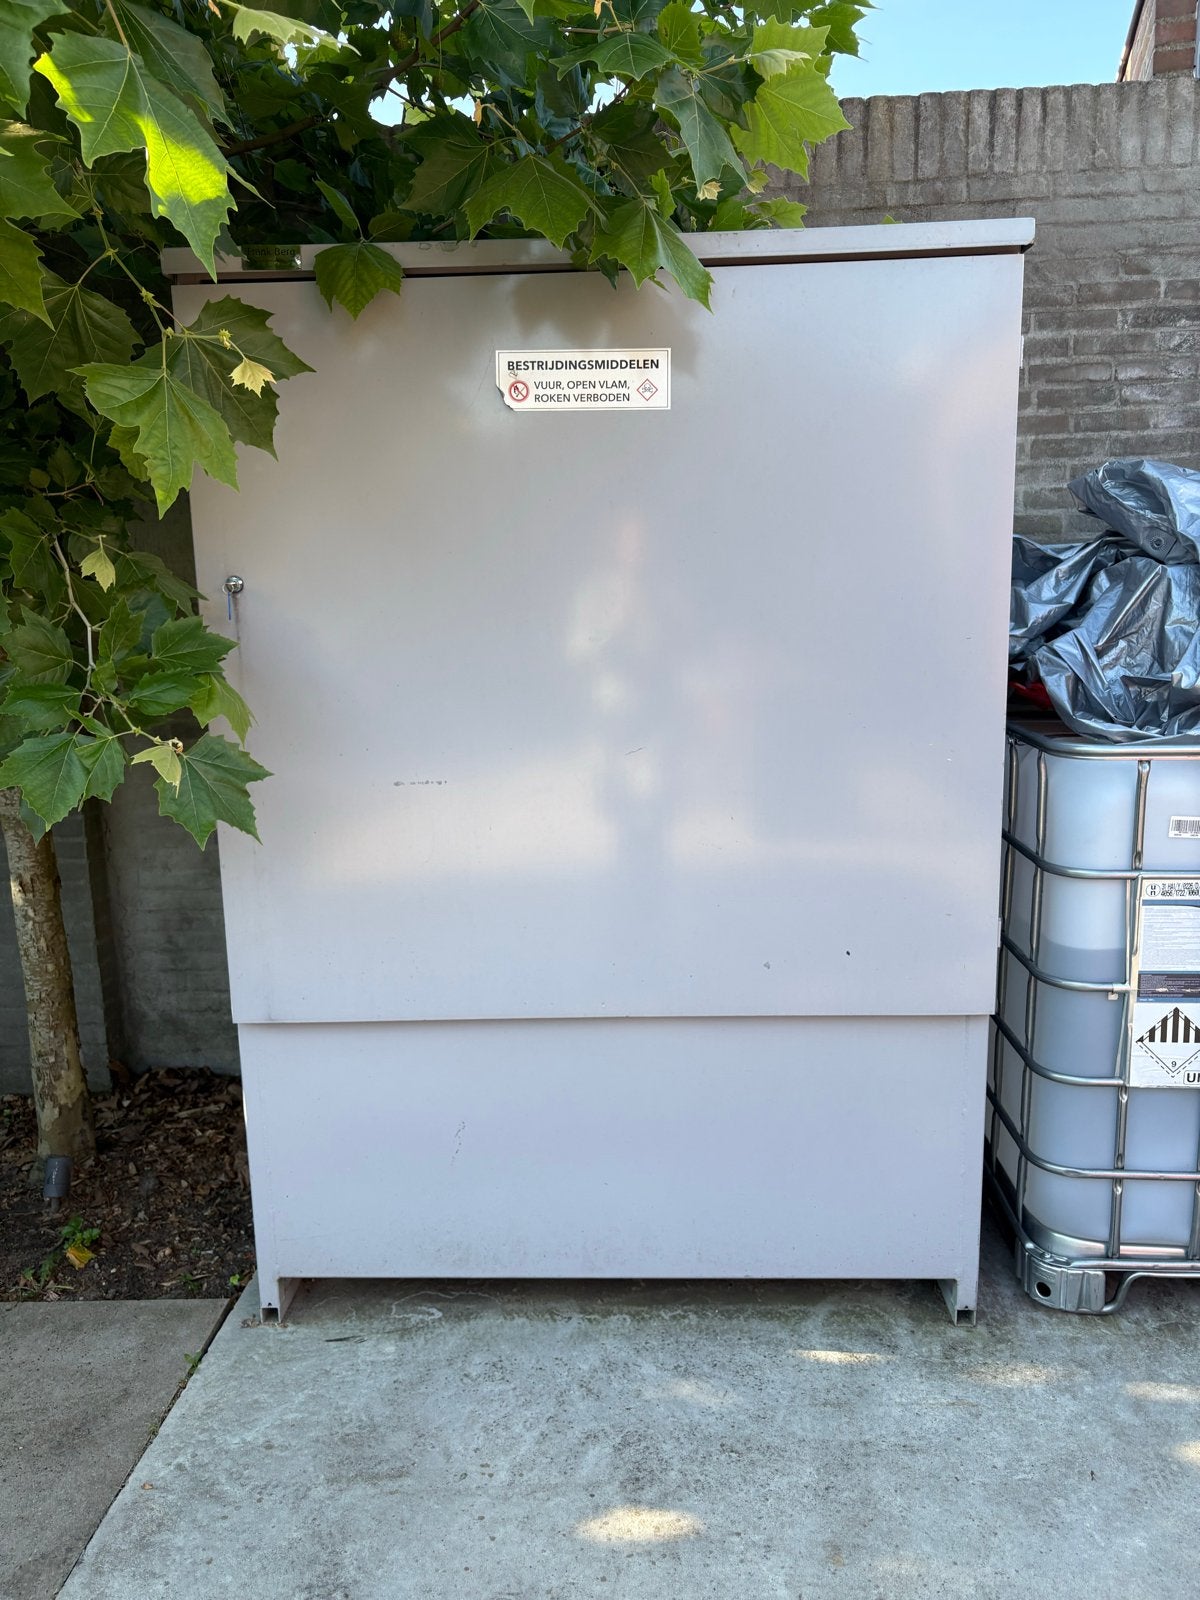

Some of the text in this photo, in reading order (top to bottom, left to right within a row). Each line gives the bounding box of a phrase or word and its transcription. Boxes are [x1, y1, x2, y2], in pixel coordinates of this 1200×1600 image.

[274, 247, 295, 258] Berg
[507, 359, 660, 371] BESTRIJDINGSMIDDELEN
[534, 379, 630, 391] VUUR, OPEN VLAM,
[534, 392, 630, 403] ROKEN VERBODEN
